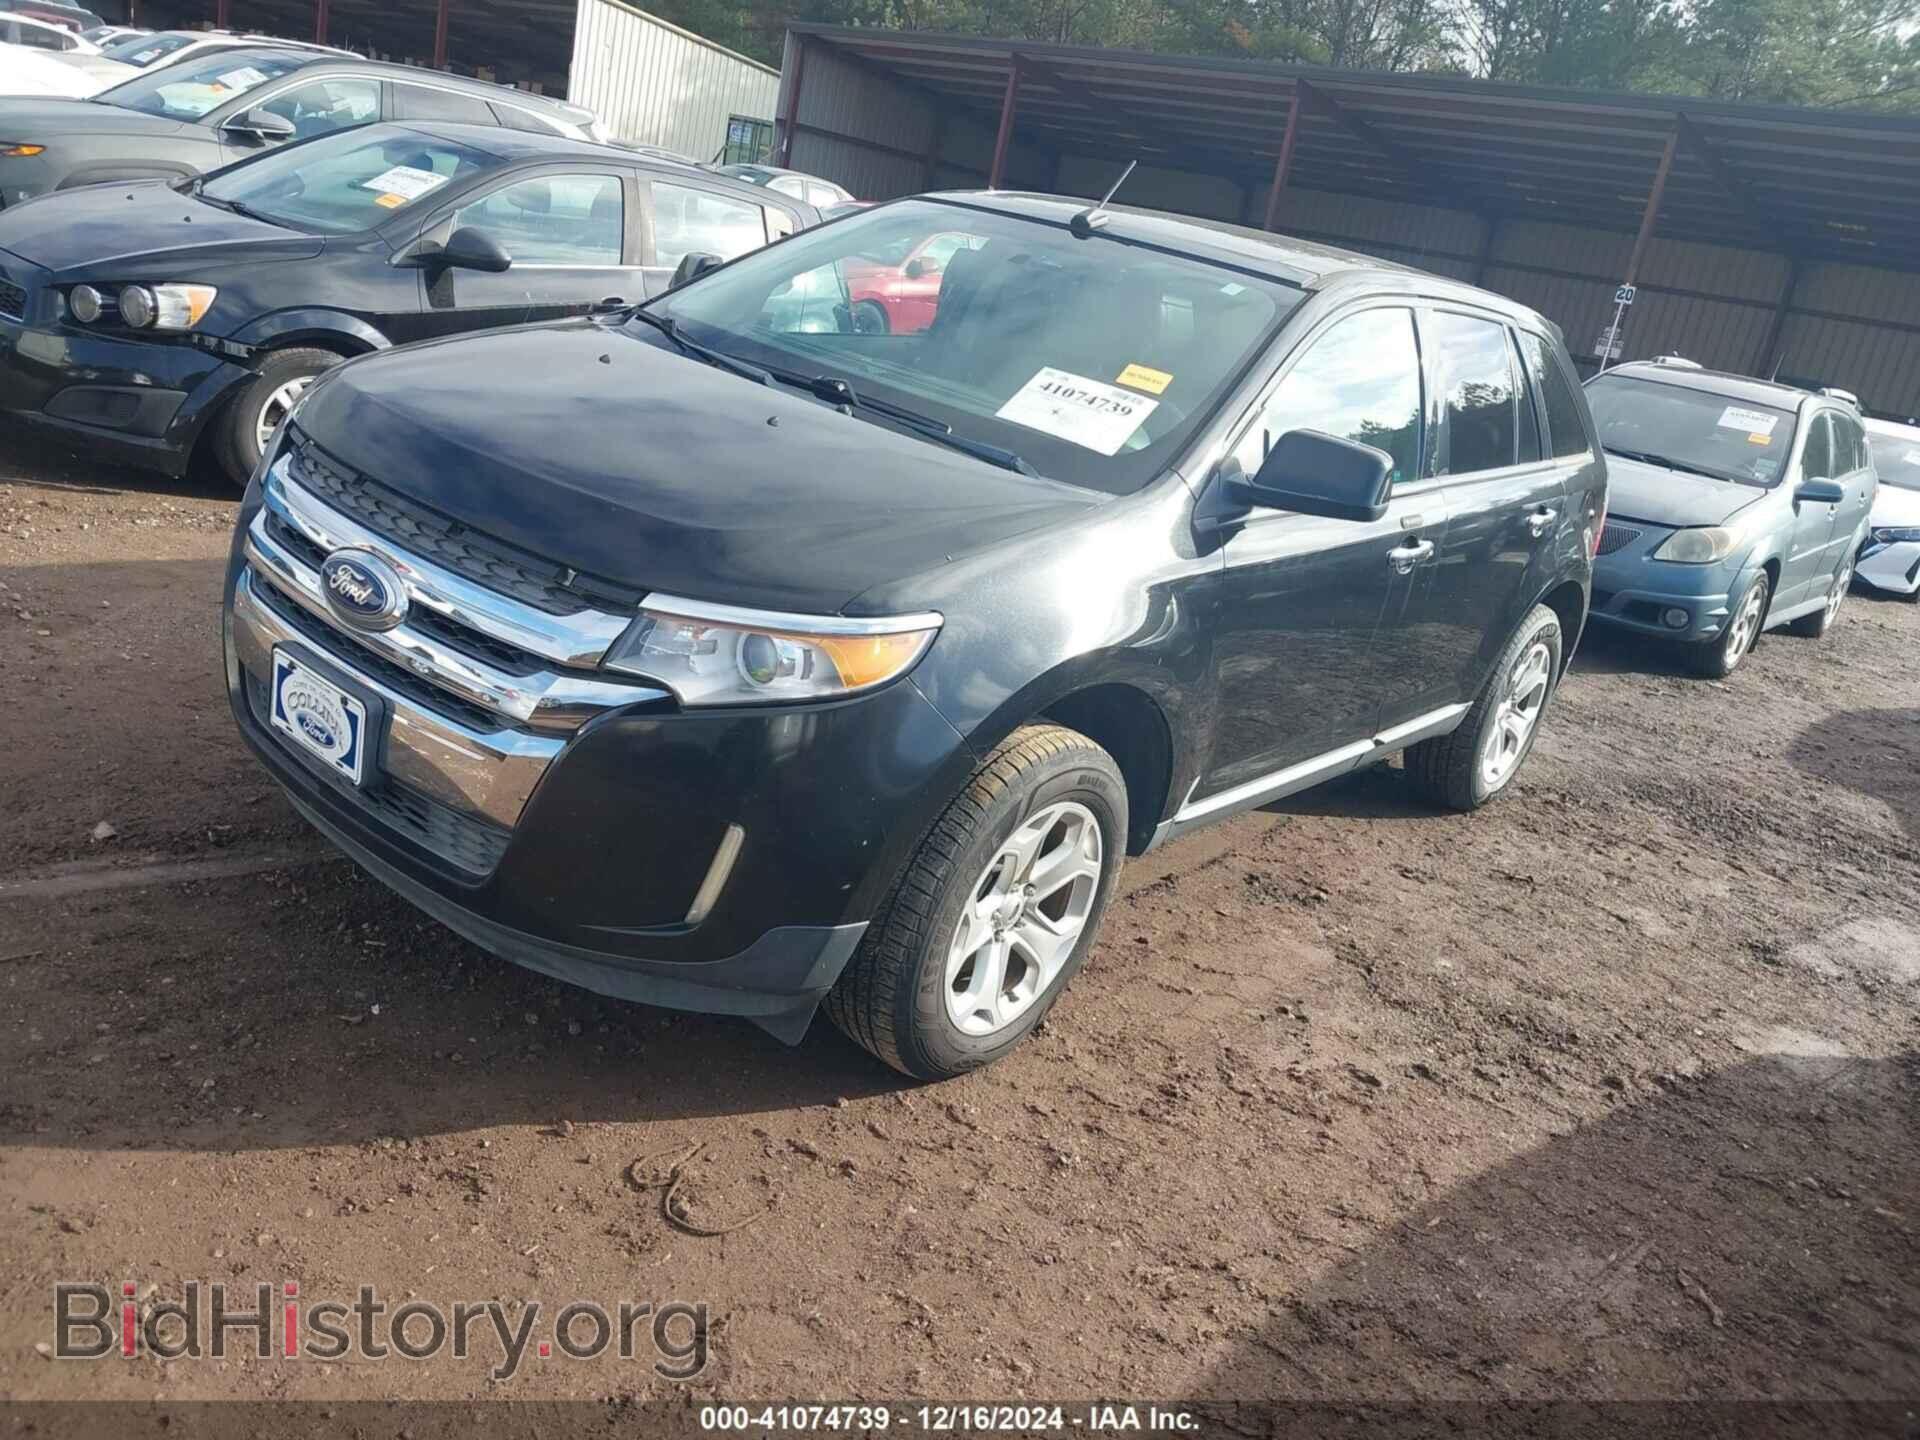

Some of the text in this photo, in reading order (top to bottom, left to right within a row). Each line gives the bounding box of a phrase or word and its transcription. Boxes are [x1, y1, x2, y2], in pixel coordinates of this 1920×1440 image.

[1616, 288, 1634, 302] 20
[1039, 382, 1133, 417] 41074739
[329, 564, 374, 606] Ford
[302, 715, 329, 744] Ford
